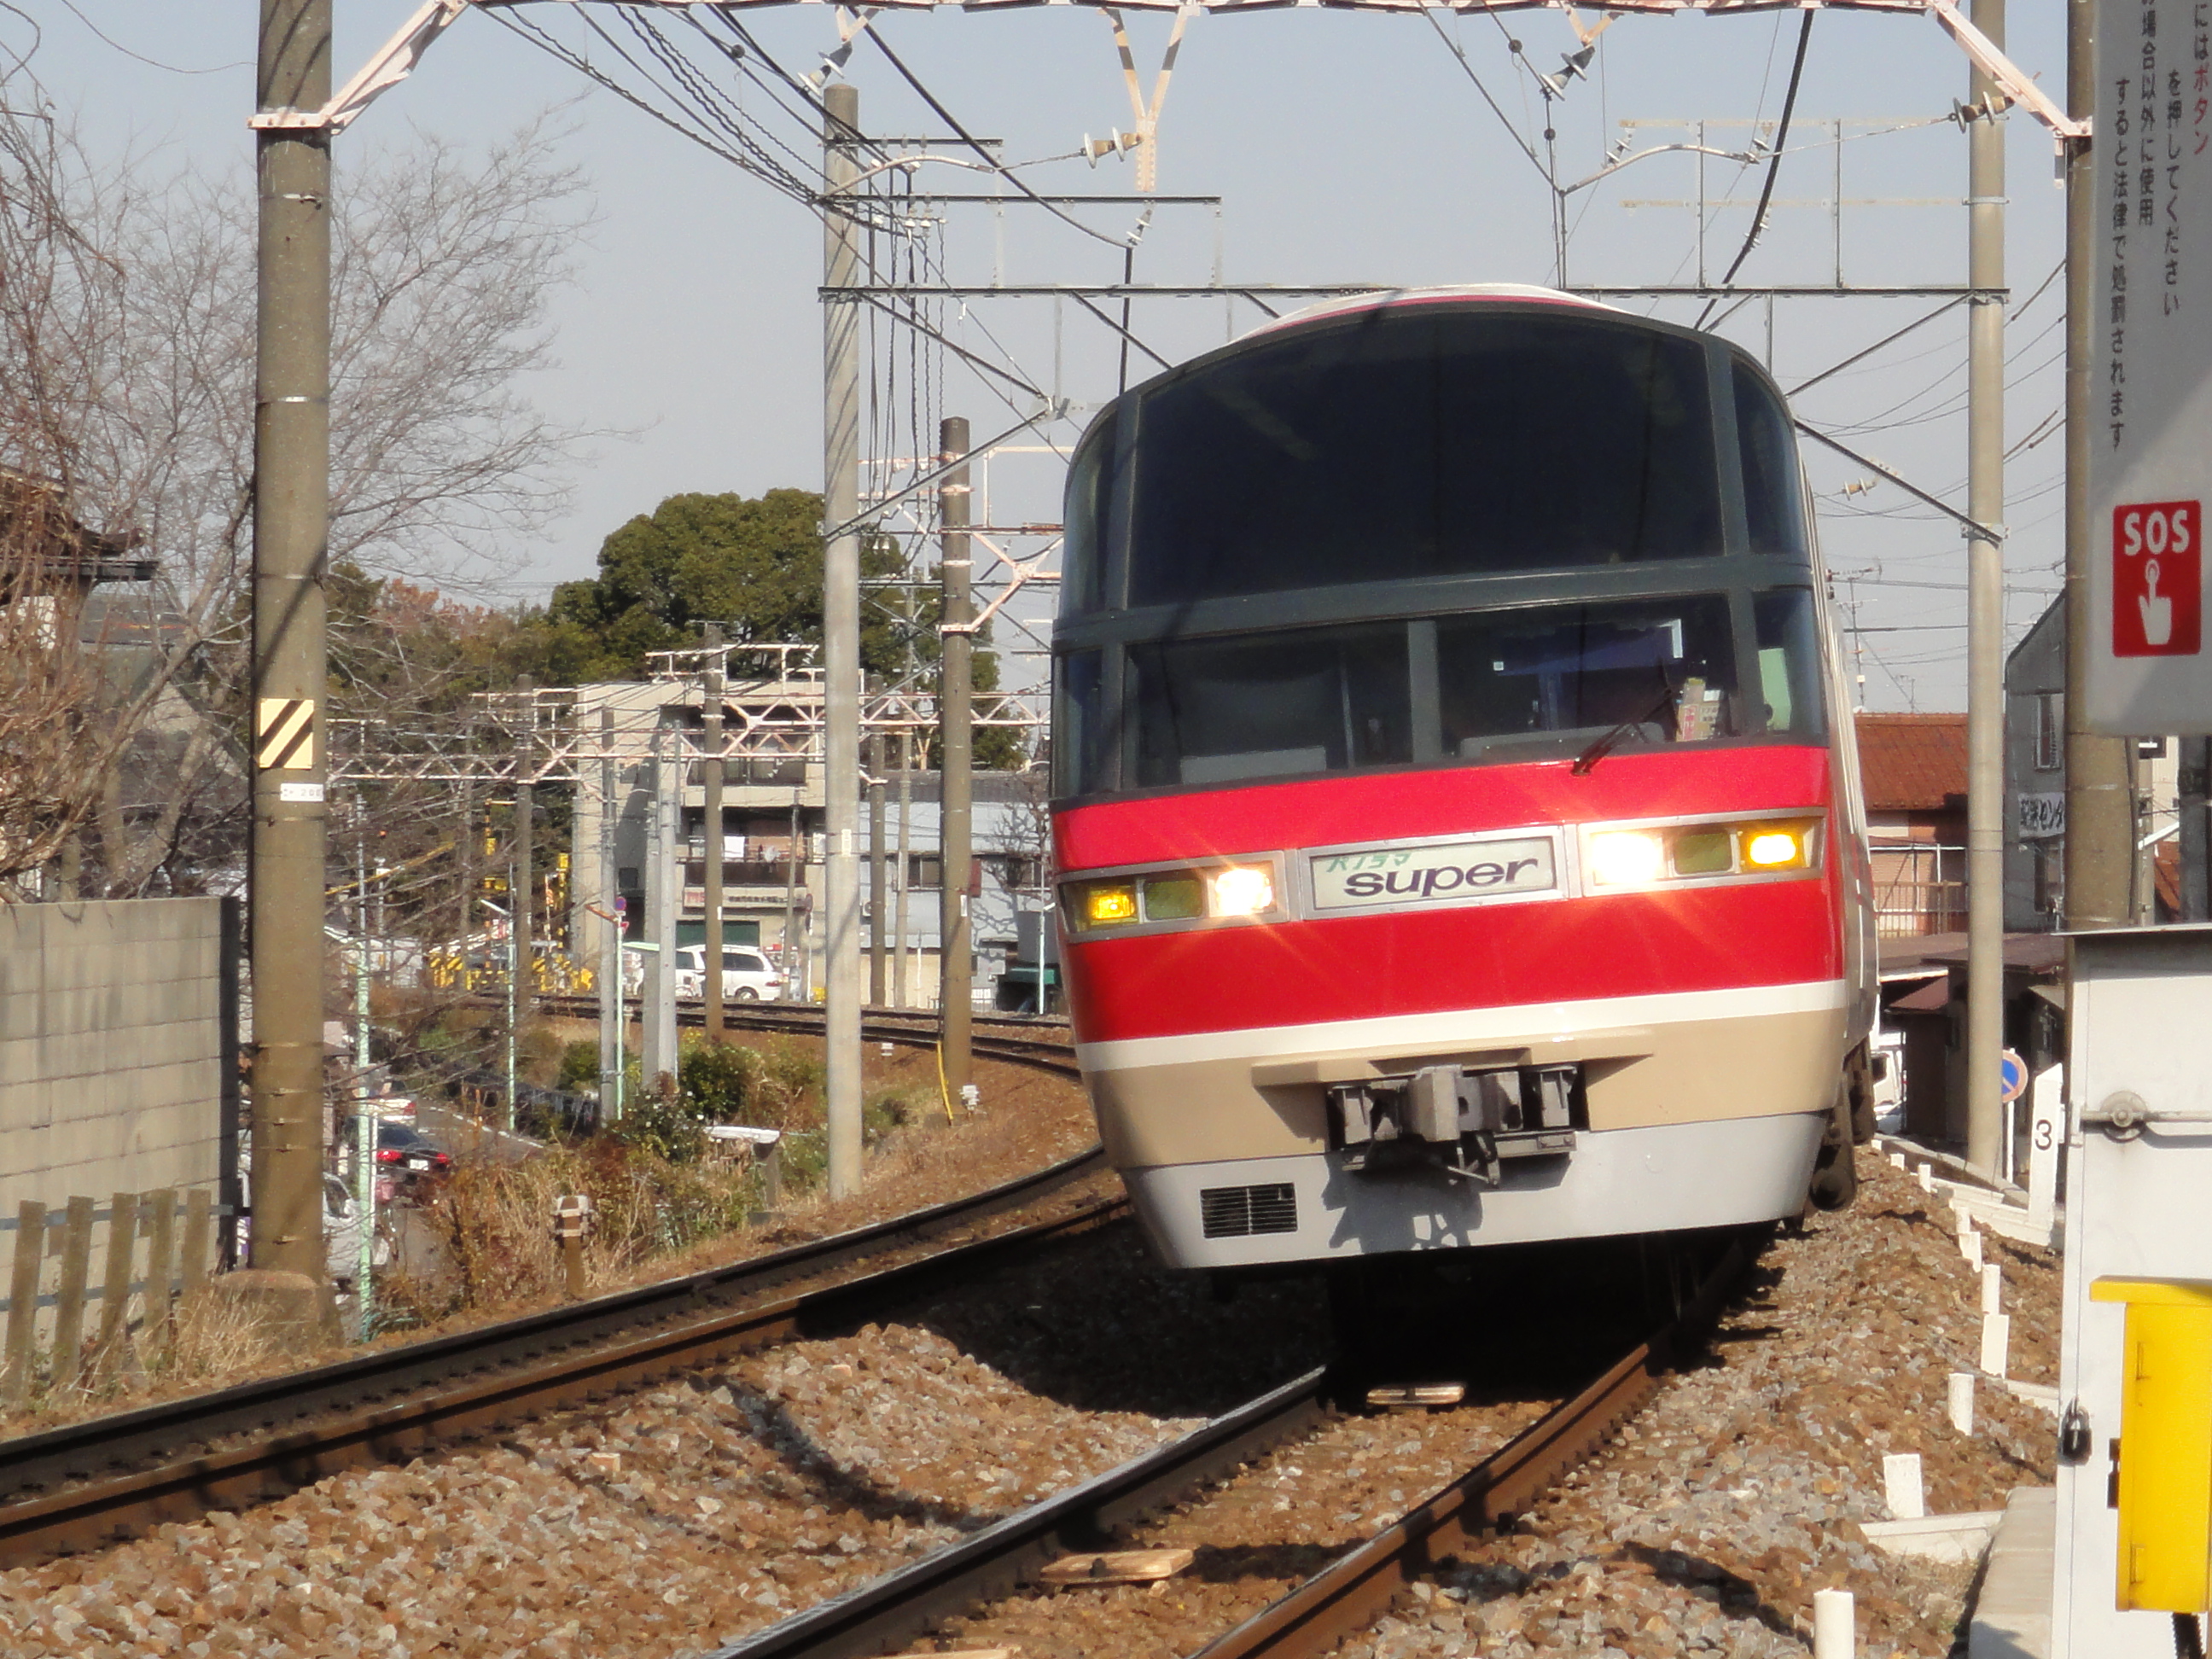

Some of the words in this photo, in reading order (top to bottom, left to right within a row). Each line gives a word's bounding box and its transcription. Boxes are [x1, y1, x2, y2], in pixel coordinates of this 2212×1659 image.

[2139, 0, 2156, 225] 場合以外に使用
[2164, 69, 2181, 315] を押してください
[2110, 79, 2130, 451] すると法律で処罰されます
[2124, 509, 2190, 556] SOS
[1343, 859, 1538, 896] super
[2034, 1119, 2052, 1150] 3
